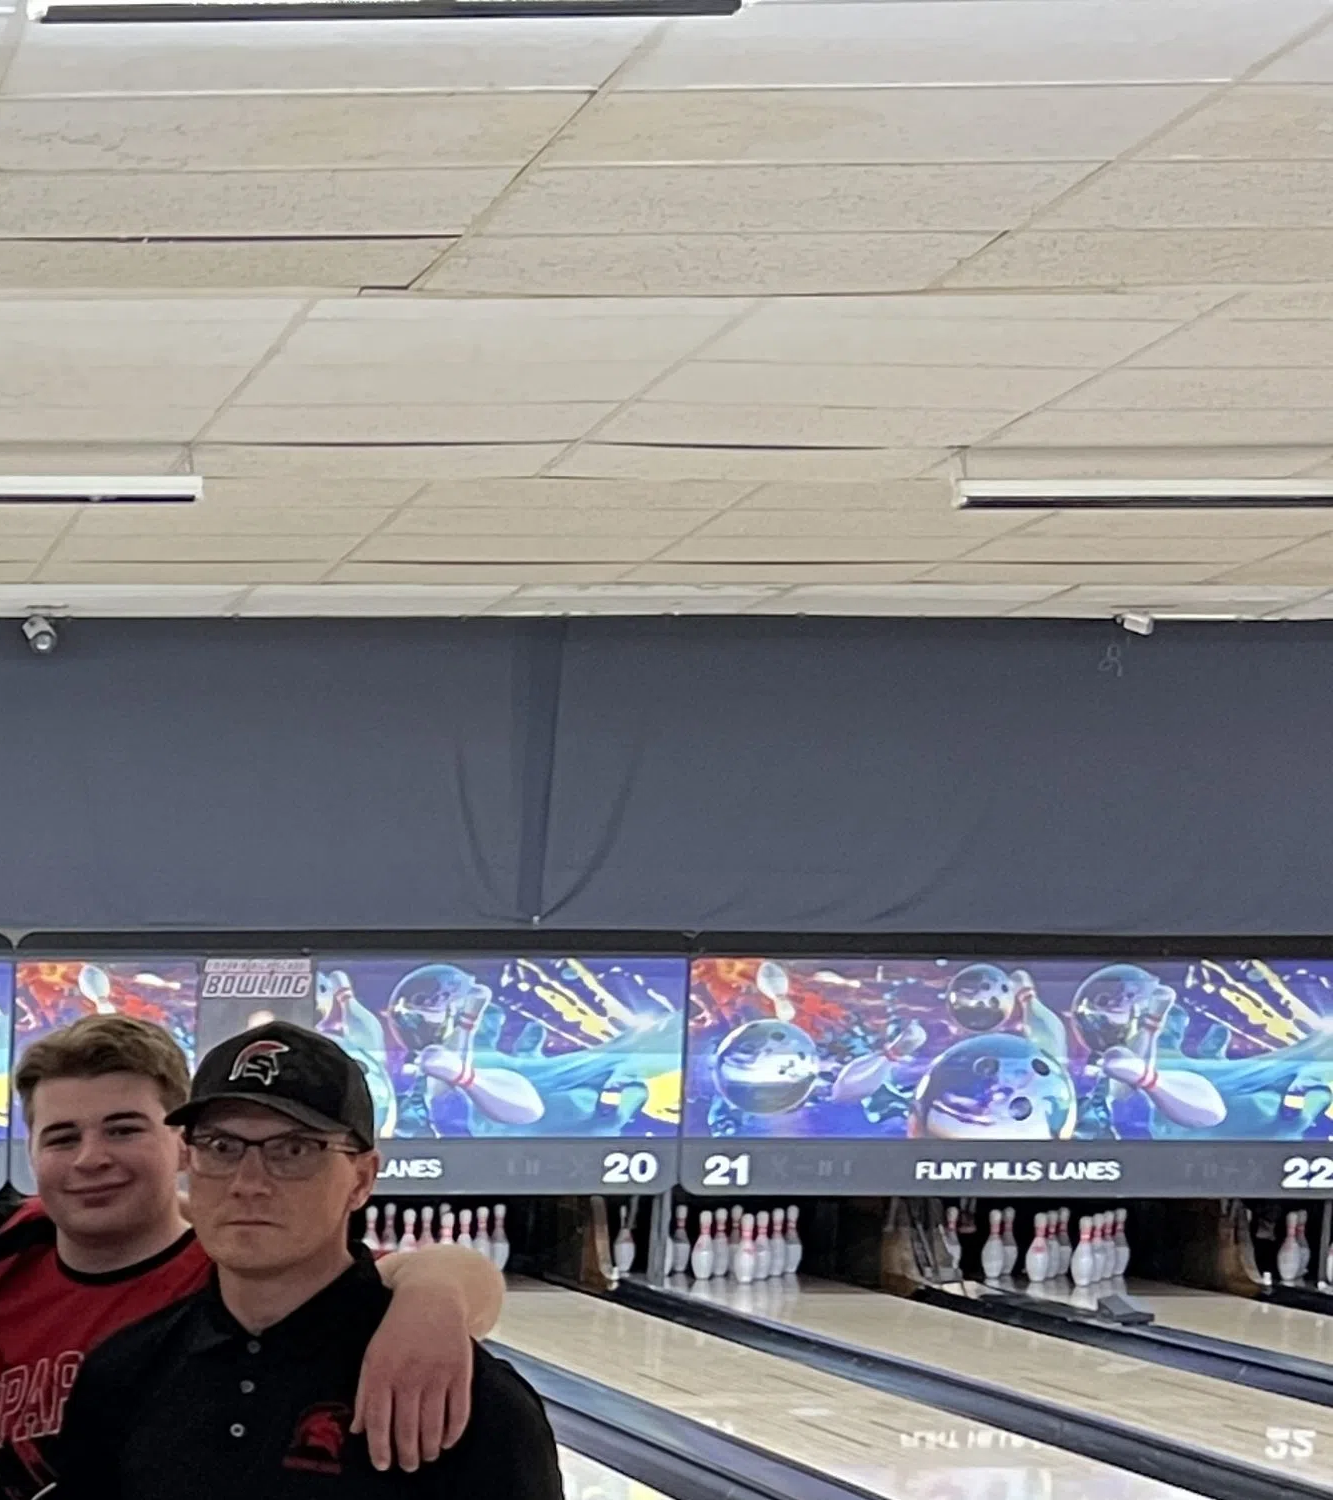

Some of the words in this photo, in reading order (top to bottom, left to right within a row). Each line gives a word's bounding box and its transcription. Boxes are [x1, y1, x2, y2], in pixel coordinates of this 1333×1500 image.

[202, 973, 312, 998] BOWLING
[602, 1152, 658, 1183] 20
[703, 1154, 751, 1186] 21
[915, 1161, 977, 1180] FLINT
[983, 1161, 1043, 1181] HILLS
[1048, 1161, 1121, 1181] LANES
[1282, 1157, 1333, 1188] 22
